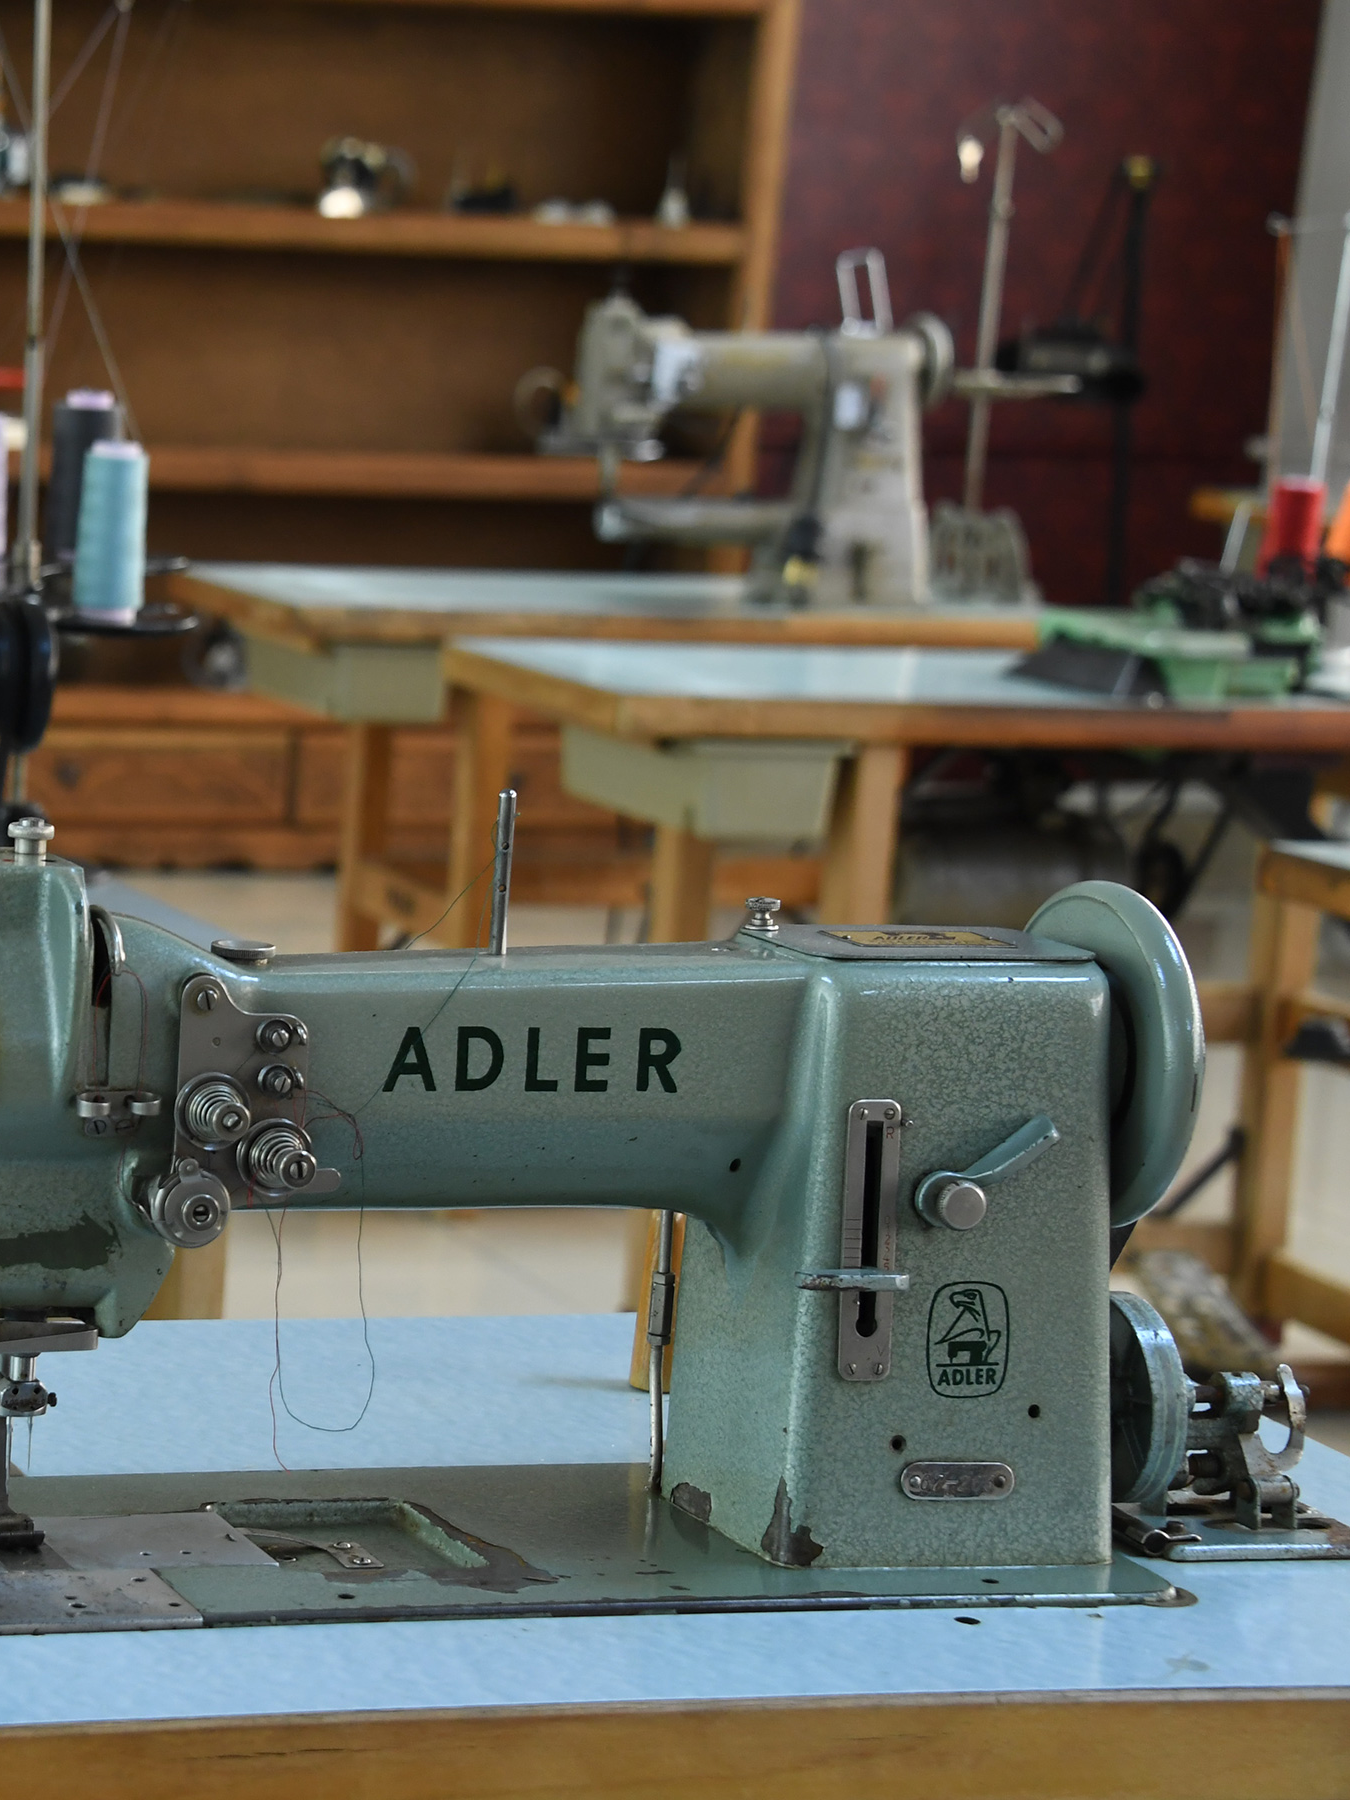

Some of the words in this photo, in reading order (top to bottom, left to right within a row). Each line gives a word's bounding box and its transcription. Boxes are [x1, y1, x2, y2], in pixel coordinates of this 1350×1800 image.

[382, 1026, 682, 1093] ADLER
[886, 1126, 894, 1139] R
[937, 1368, 996, 1386] ADLER
